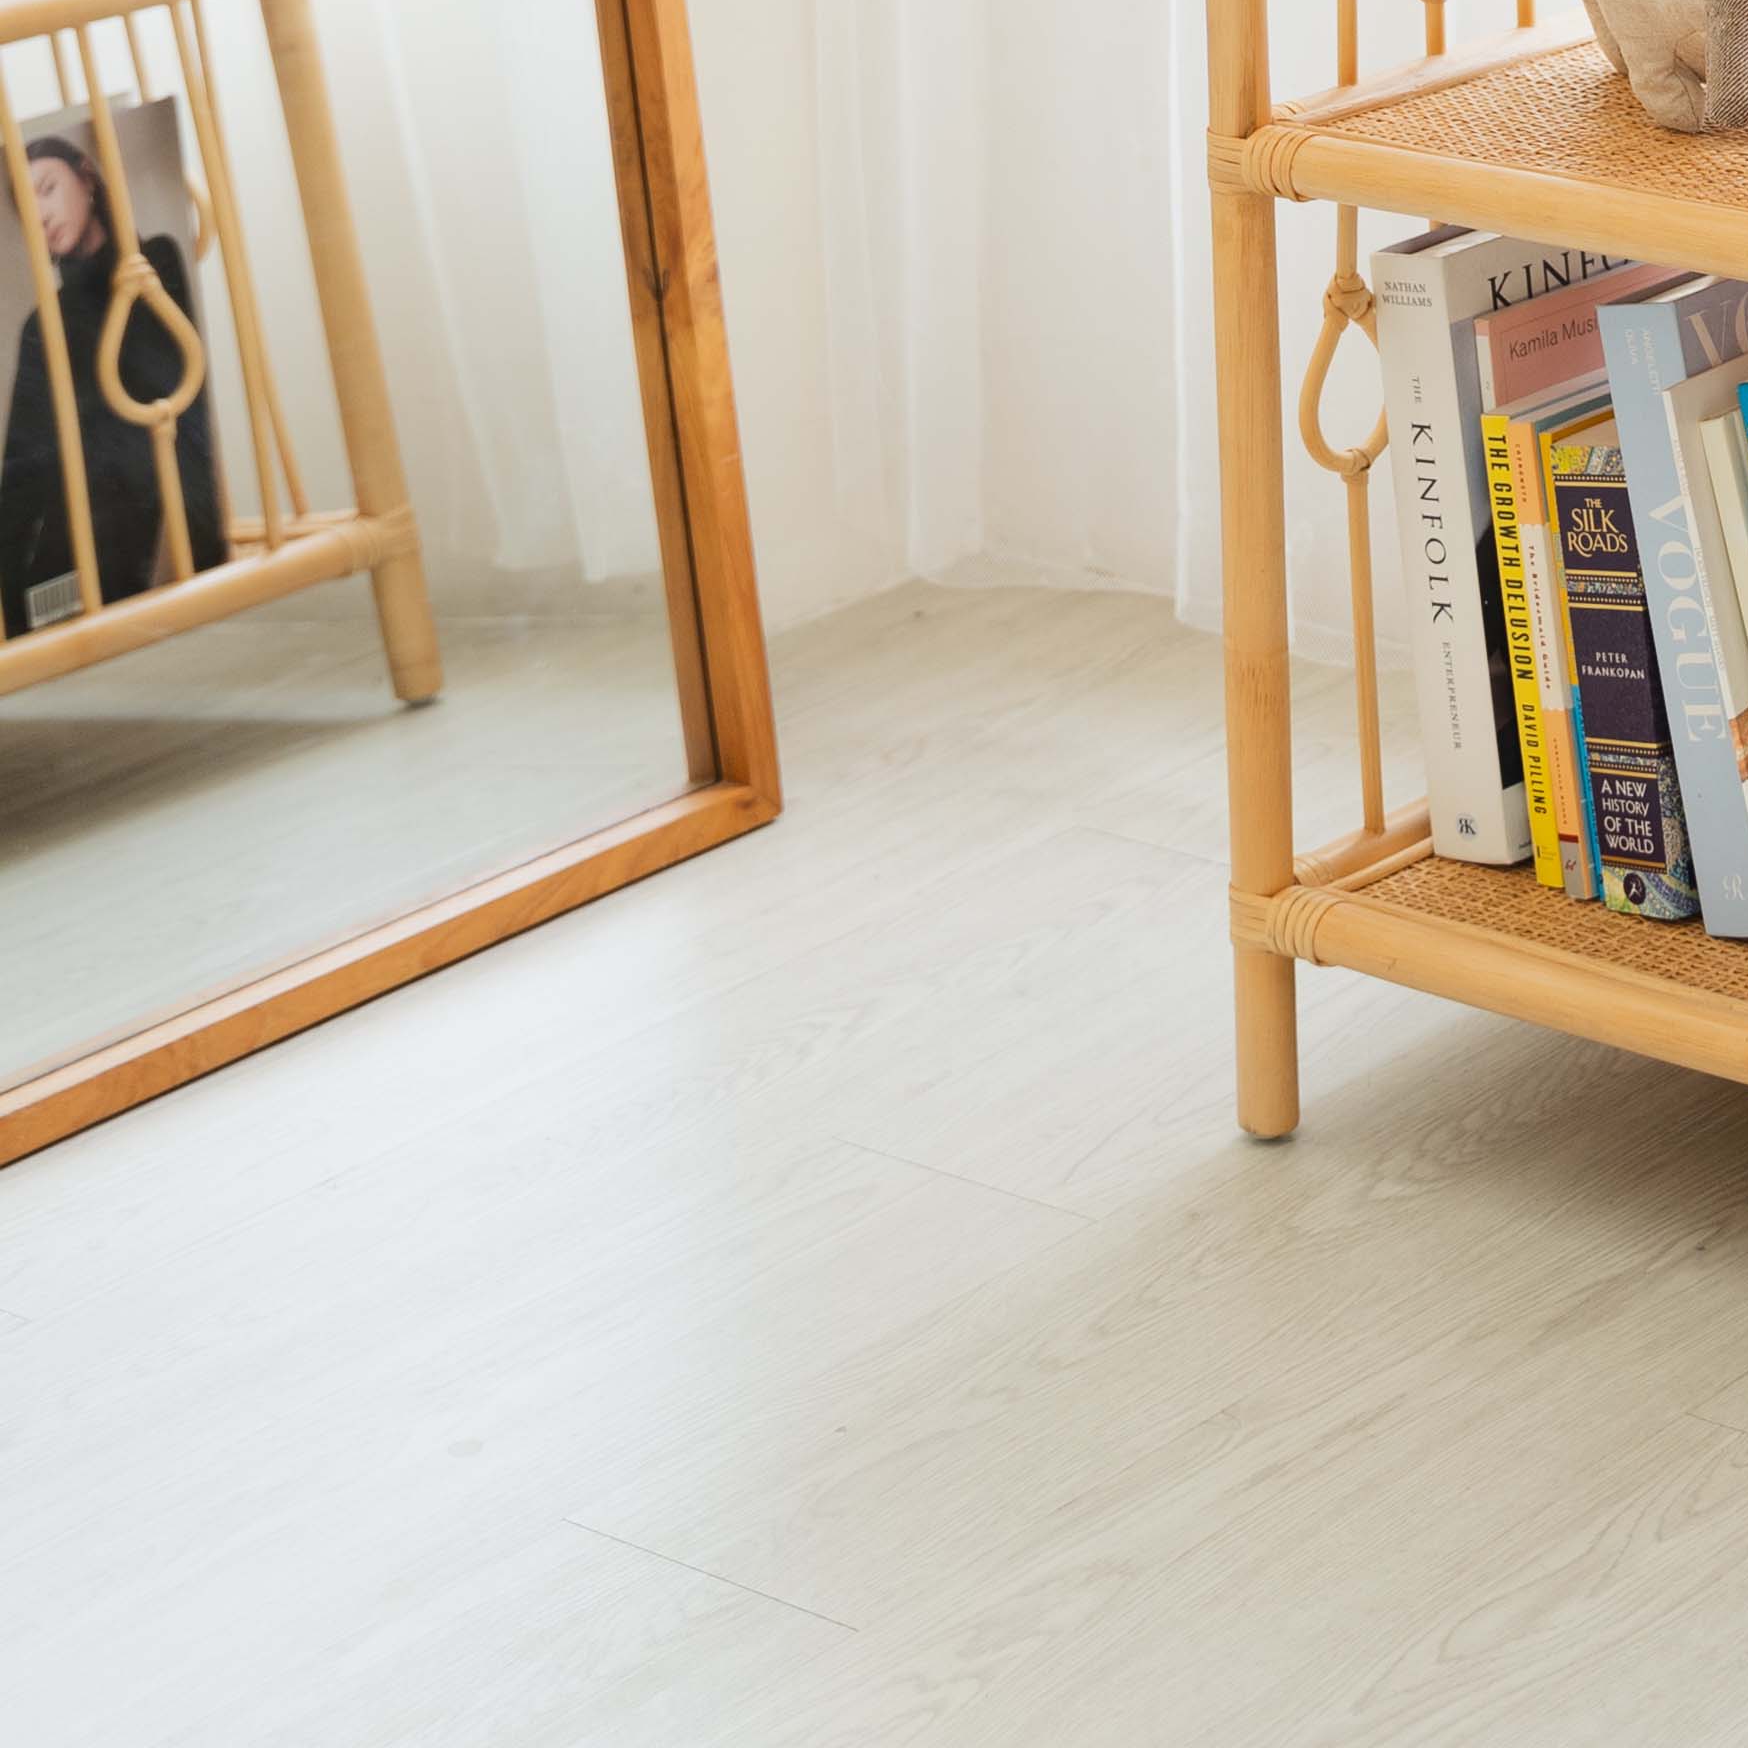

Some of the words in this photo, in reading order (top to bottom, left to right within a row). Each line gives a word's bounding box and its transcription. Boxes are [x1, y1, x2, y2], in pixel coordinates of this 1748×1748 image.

[1384, 281, 1427, 294] NATHAN
[1488, 250, 1630, 312] KINF
[1381, 295, 1433, 308] WILLIAMS
[1508, 329, 1560, 360] Kamila
[1411, 376, 1423, 404] THE
[1488, 435, 1511, 471] THE
[1584, 497, 1602, 509] THE
[1411, 421, 1454, 624] KINFOLK
[1493, 482, 1521, 568] GROWTH
[1571, 507, 1620, 534] SILK
[1567, 531, 1629, 558] ROADS
[1504, 578, 1534, 680] DELUSION
[1648, 493, 1728, 743] VOGUE
[1595, 651, 1629, 663] PETER
[1581, 664, 1646, 680] FRANKOPAN
[1522, 703, 1539, 748] DAVID
[1528, 755, 1548, 815] PILLING
[1601, 778, 1613, 796] A
[1615, 779, 1647, 798] NEW
[1602, 798, 1650, 817] HISTORY
[1604, 815, 1623, 833] OF
[1624, 817, 1653, 838] THE
[1605, 833, 1655, 855] WORLD
